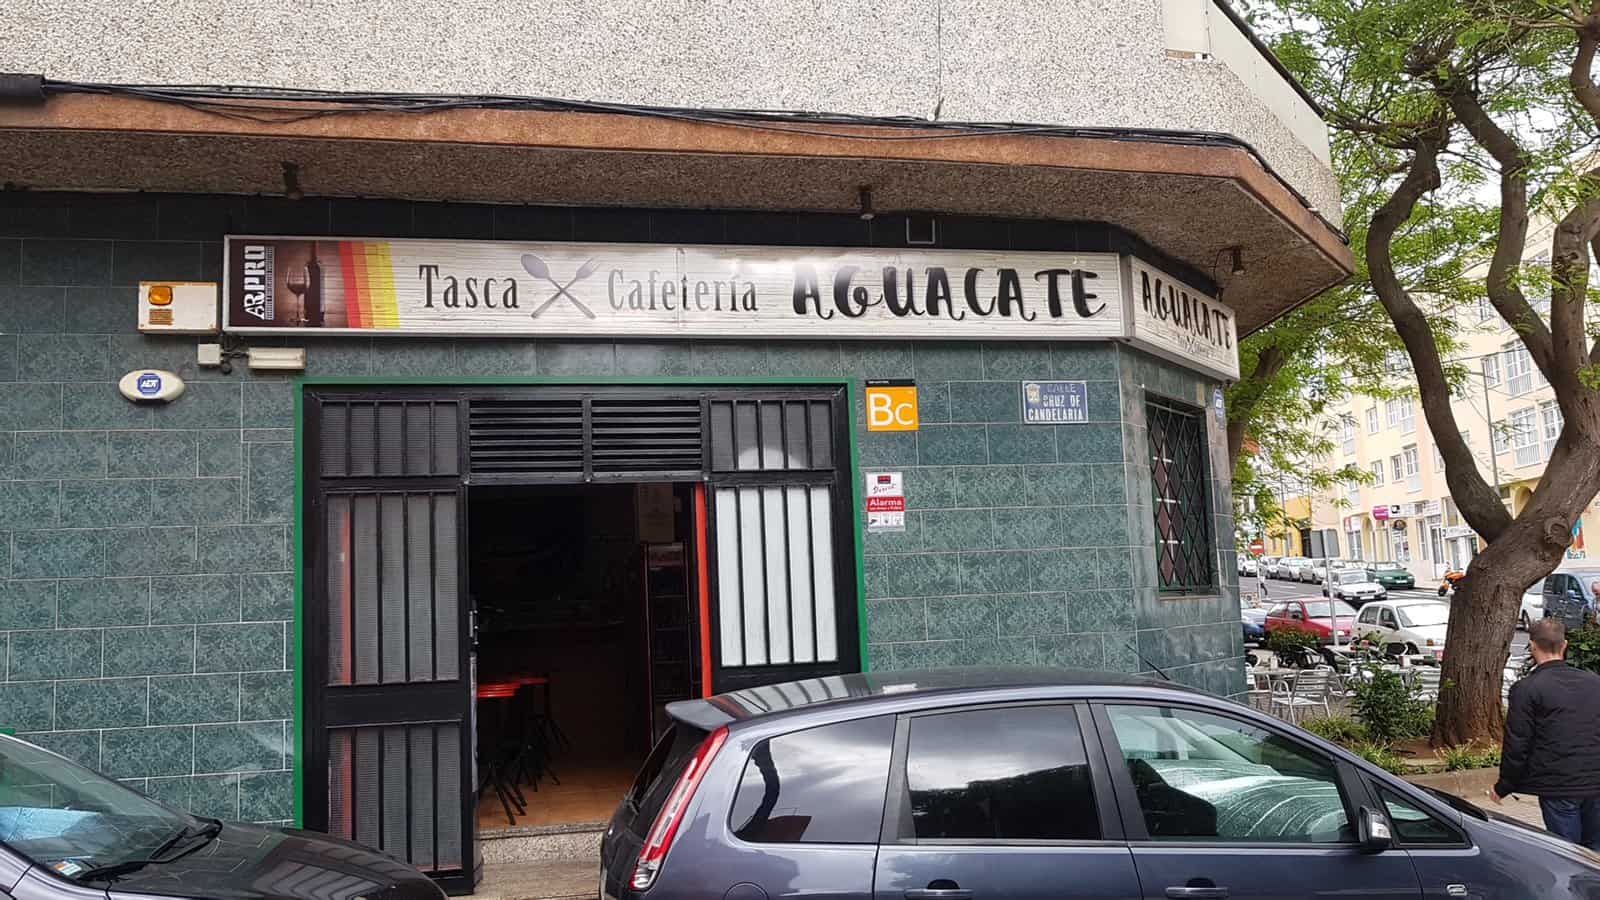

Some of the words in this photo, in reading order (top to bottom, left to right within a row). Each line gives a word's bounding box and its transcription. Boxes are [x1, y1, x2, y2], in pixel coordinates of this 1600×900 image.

[418, 264, 521, 309] Tasca
[607, 267, 759, 312] Cafetería
[792, 266, 1107, 321] AGUACATE
[1140, 270, 1234, 350] AGUACATE
[1047, 383, 1078, 393] CALLE
[1042, 394, 1065, 407] CRUZ
[1070, 394, 1081, 407] DE
[869, 393, 914, 427] Bc
[1027, 407, 1084, 421] CANDELARIA
[869, 498, 903, 506] Alarma
